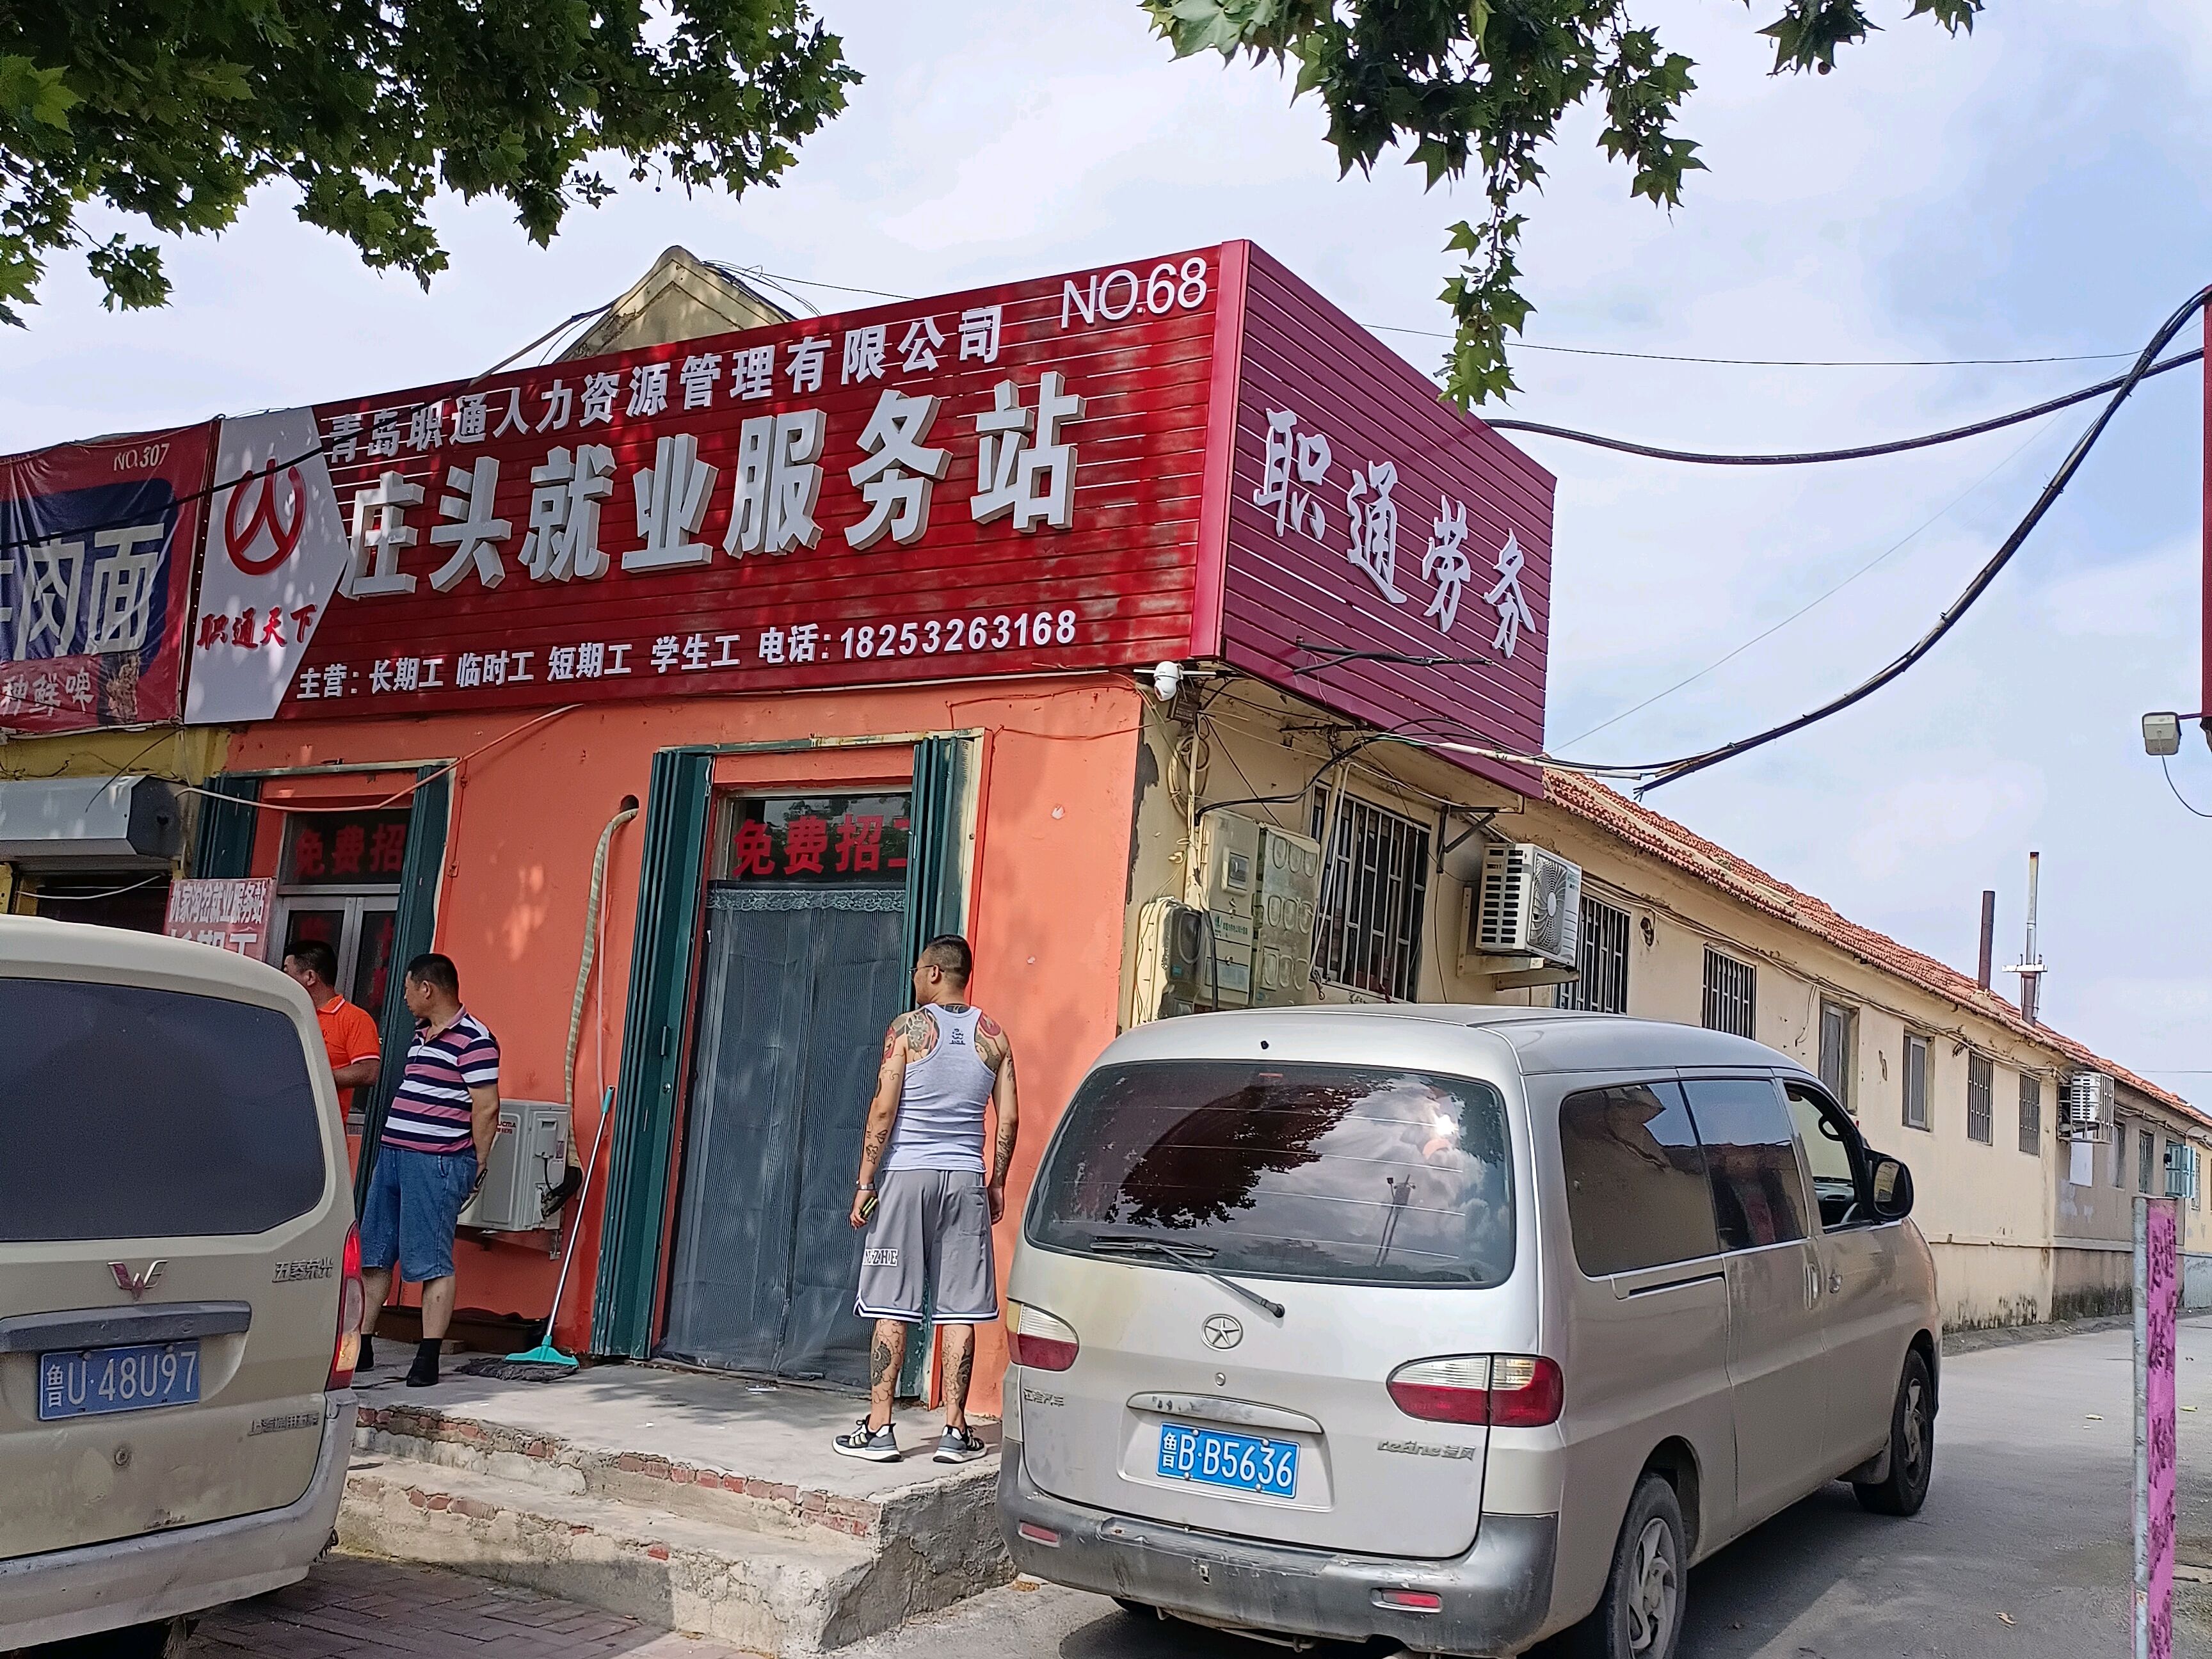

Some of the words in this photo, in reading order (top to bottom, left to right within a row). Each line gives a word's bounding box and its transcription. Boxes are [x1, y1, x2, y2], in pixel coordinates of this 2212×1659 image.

[1061, 257, 1208, 328] NO.68
[328, 305, 1003, 464] 青岛职通人力资源管理有限公司
[113, 443, 170, 471] NO.307
[339, 371, 1087, 600] 庄头就业服务站
[1253, 408, 1536, 659] 职通劳务
[0, 522, 164, 661] 肉面
[196, 604, 316, 650] 职通天下
[369, 657, 444, 694] 长期工
[456, 650, 535, 689] 临时工
[547, 643, 632, 682] 短期工
[650, 634, 741, 673] 学生工
[840, 609, 1076, 659] 18253263168
